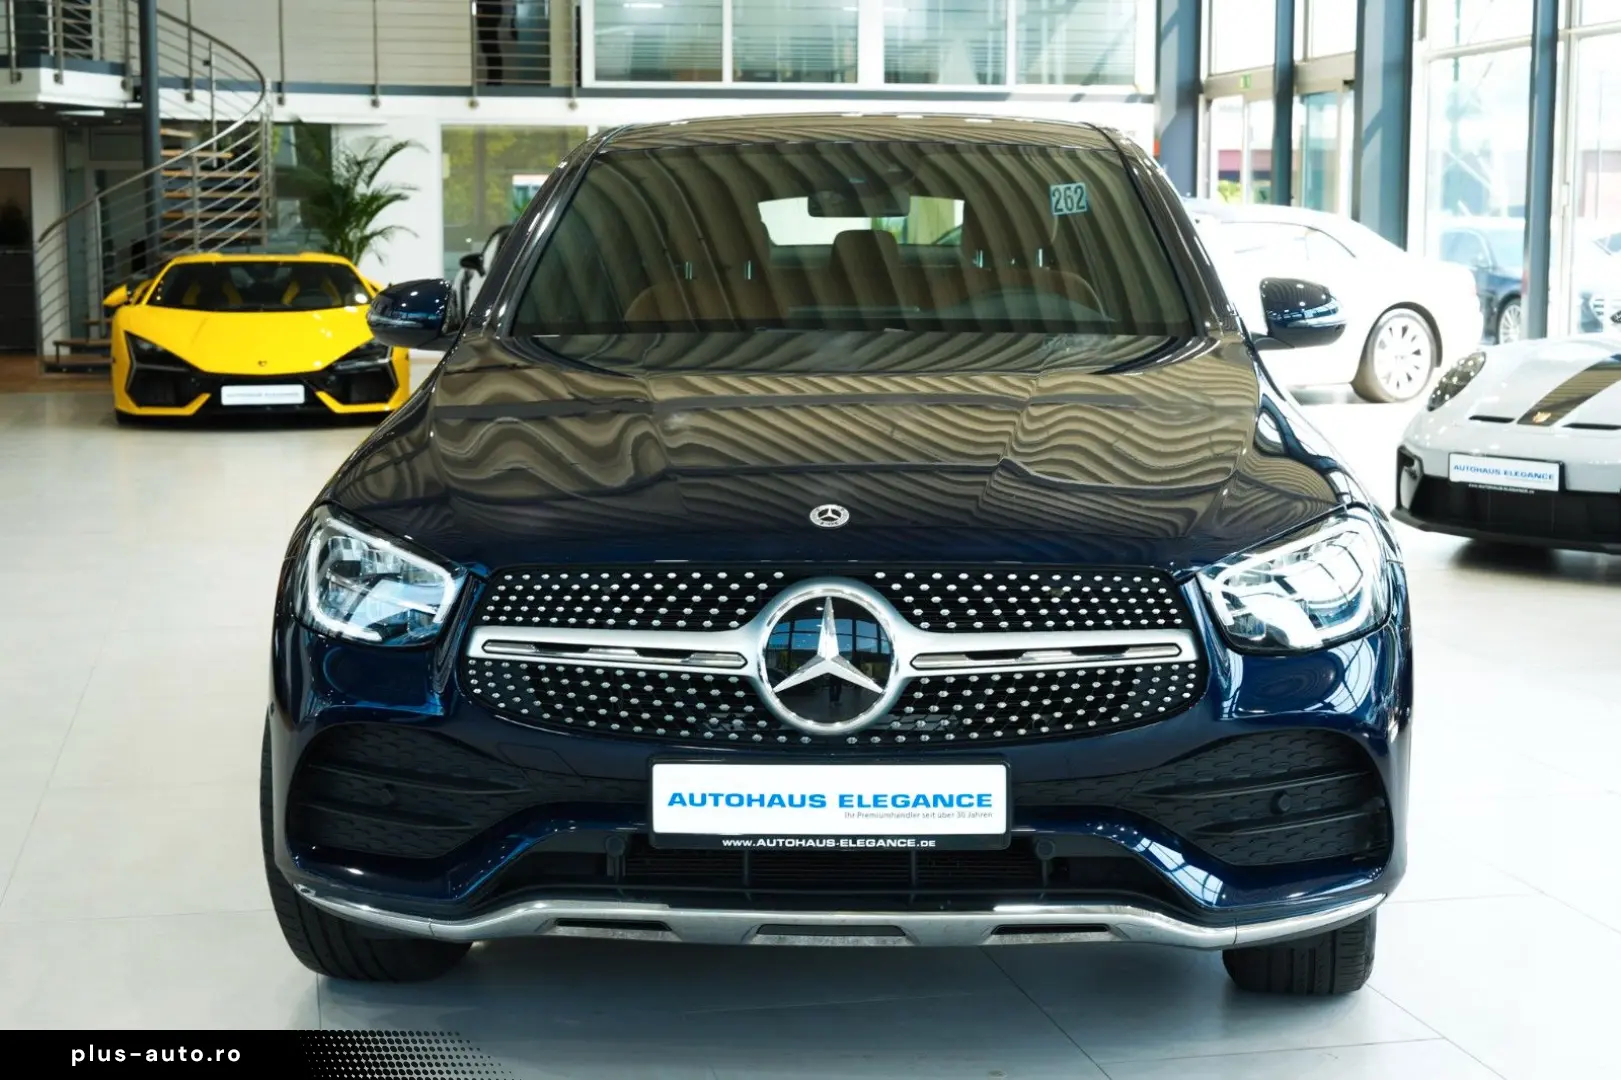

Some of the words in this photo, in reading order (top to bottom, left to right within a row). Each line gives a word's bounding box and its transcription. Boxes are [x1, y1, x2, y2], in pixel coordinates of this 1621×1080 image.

[1052, 184, 1086, 212] 262
[1453, 464, 1501, 476] AUTOHAUS
[1503, 470, 1554, 480] ELEGANCE
[667, 793, 827, 808] AUTOHAUS
[839, 793, 993, 808] ELEGANCE
[844, 811, 855, 819] Ihr
[922, 811, 936, 819] seit
[967, 811, 993, 819] Jahren
